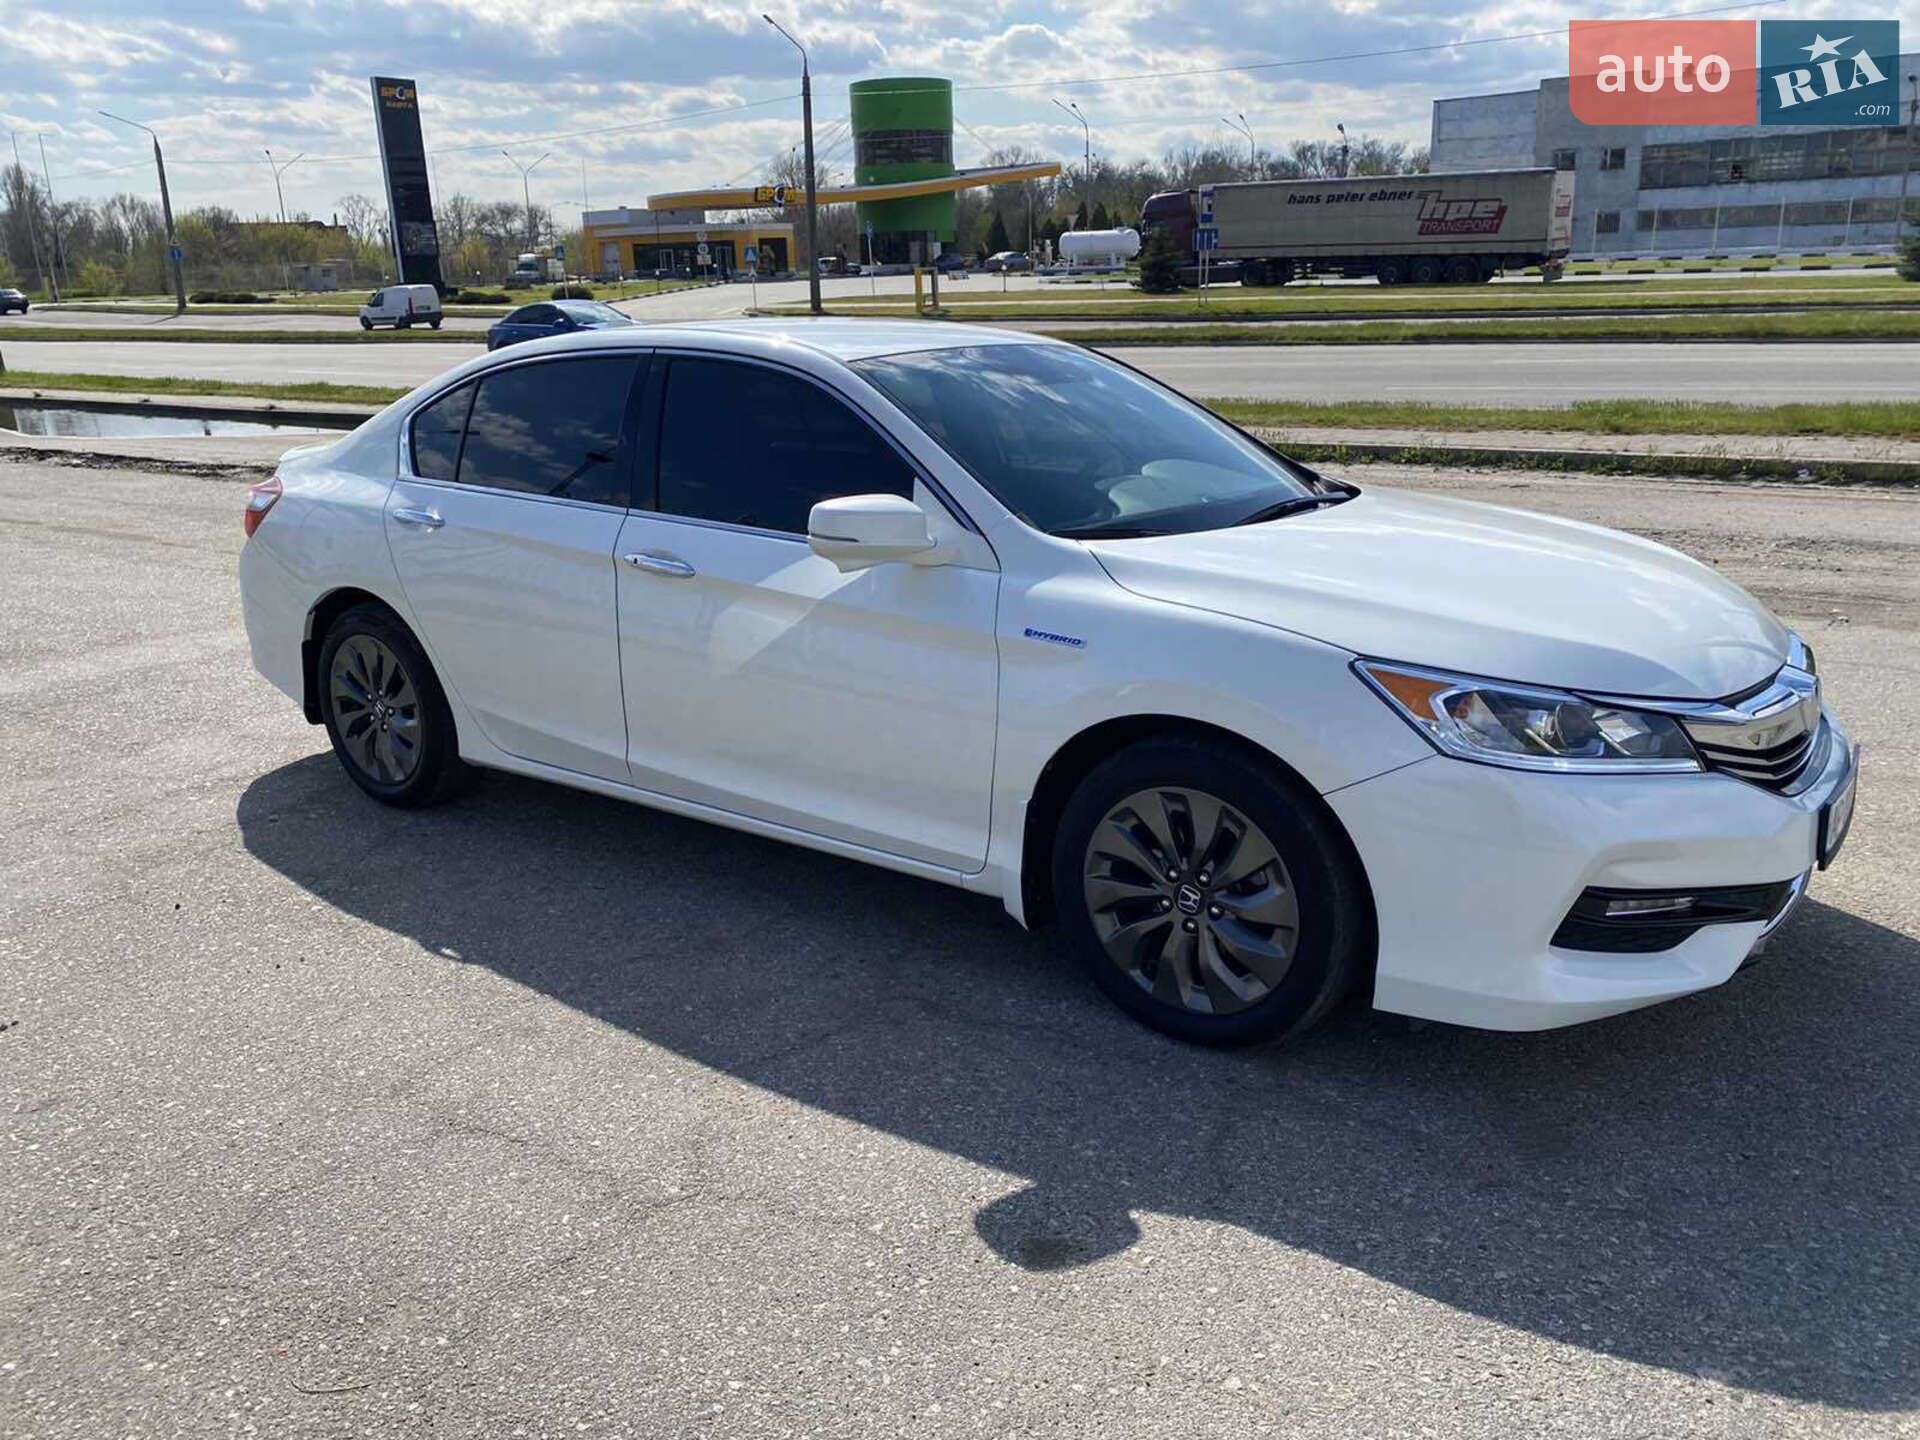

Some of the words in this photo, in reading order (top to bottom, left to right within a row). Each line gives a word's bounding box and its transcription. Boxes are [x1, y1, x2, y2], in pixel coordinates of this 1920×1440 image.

[1287, 193, 1323, 205] hans
[1367, 189, 1414, 202] ebner
[1421, 219, 1499, 233] TRANSPORT
[1032, 630, 1082, 646] HYBRID
